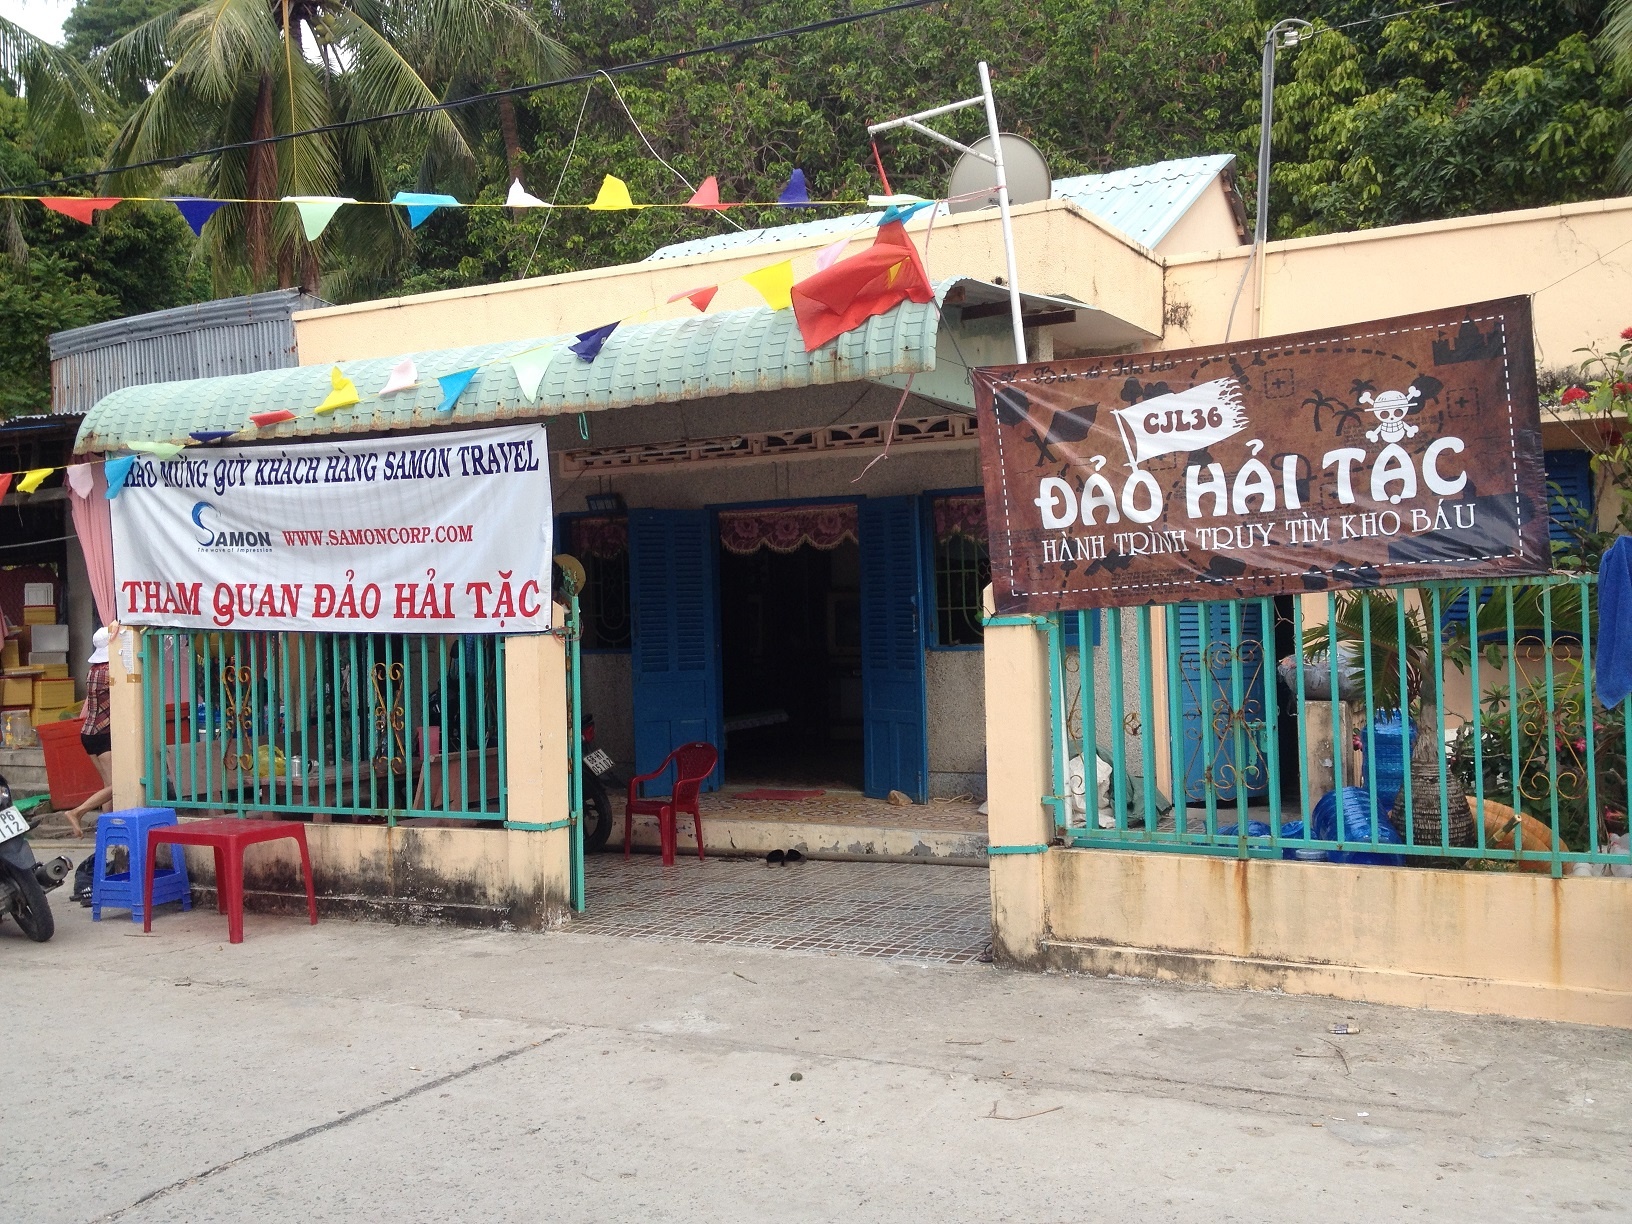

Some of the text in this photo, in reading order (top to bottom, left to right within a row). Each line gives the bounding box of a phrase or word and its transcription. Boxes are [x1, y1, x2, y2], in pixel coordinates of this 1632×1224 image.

[1143, 407, 1223, 435] CJL36
[123, 453, 158, 488] HÀO
[323, 447, 379, 483] HÀNG
[383, 447, 453, 481] SAMON
[457, 439, 540, 476] TRAVEL
[1034, 454, 1164, 530] ĐẢO
[1185, 438, 1301, 517] HẢI
[282, 525, 474, 547] WWW.SAMONCORP.COM
[1041, 531, 1107, 564] HÀNH
[1114, 525, 1193, 557] TRÌNH
[1195, 522, 1276, 550] TRUY
[1285, 511, 1331, 544] TÌM
[1340, 509, 1401, 540] KHO
[1411, 498, 1476, 533] BÁU
[122, 568, 541, 628] THAM QUAN ĐẢO HẢI TẶC
